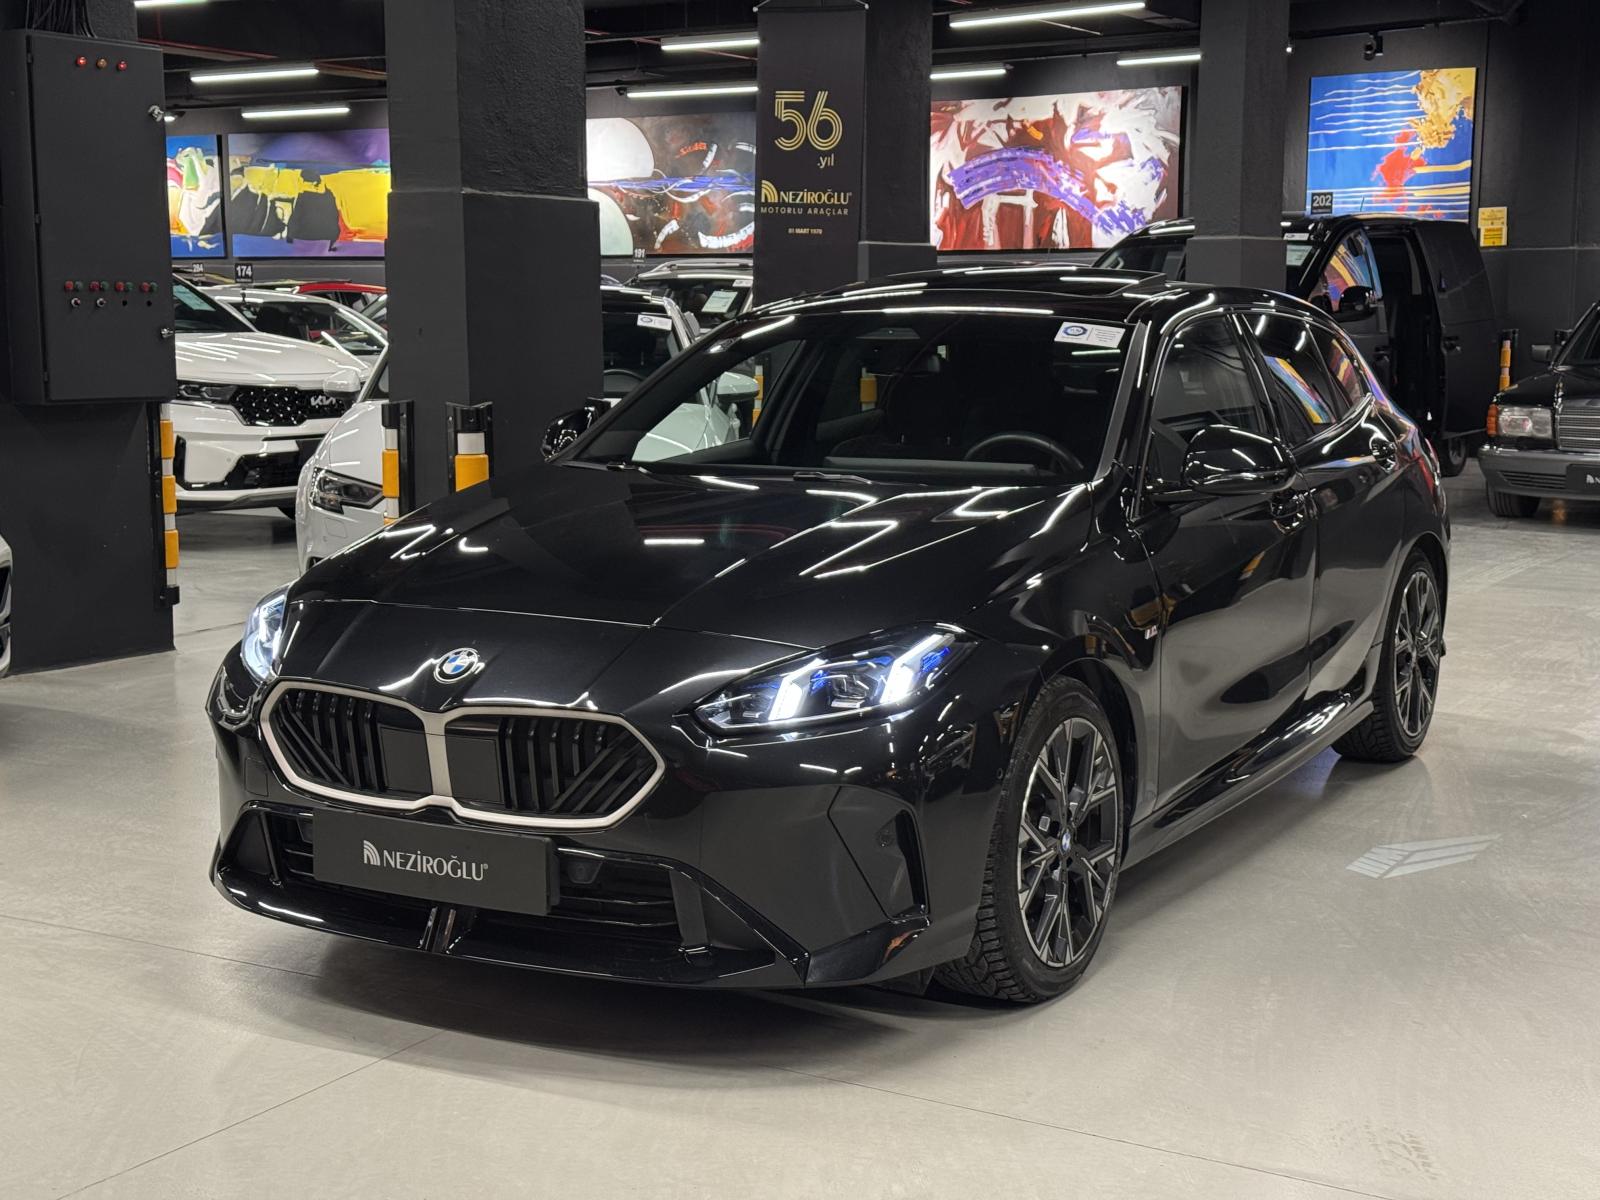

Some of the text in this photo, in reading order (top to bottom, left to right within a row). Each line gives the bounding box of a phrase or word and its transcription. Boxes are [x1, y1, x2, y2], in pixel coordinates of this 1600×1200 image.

[775, 91, 843, 151] 56
[1312, 194, 1332, 207] 202
[760, 206, 849, 217] MOTORLU ARAÇLAR
[236, 265, 252, 278] 174
